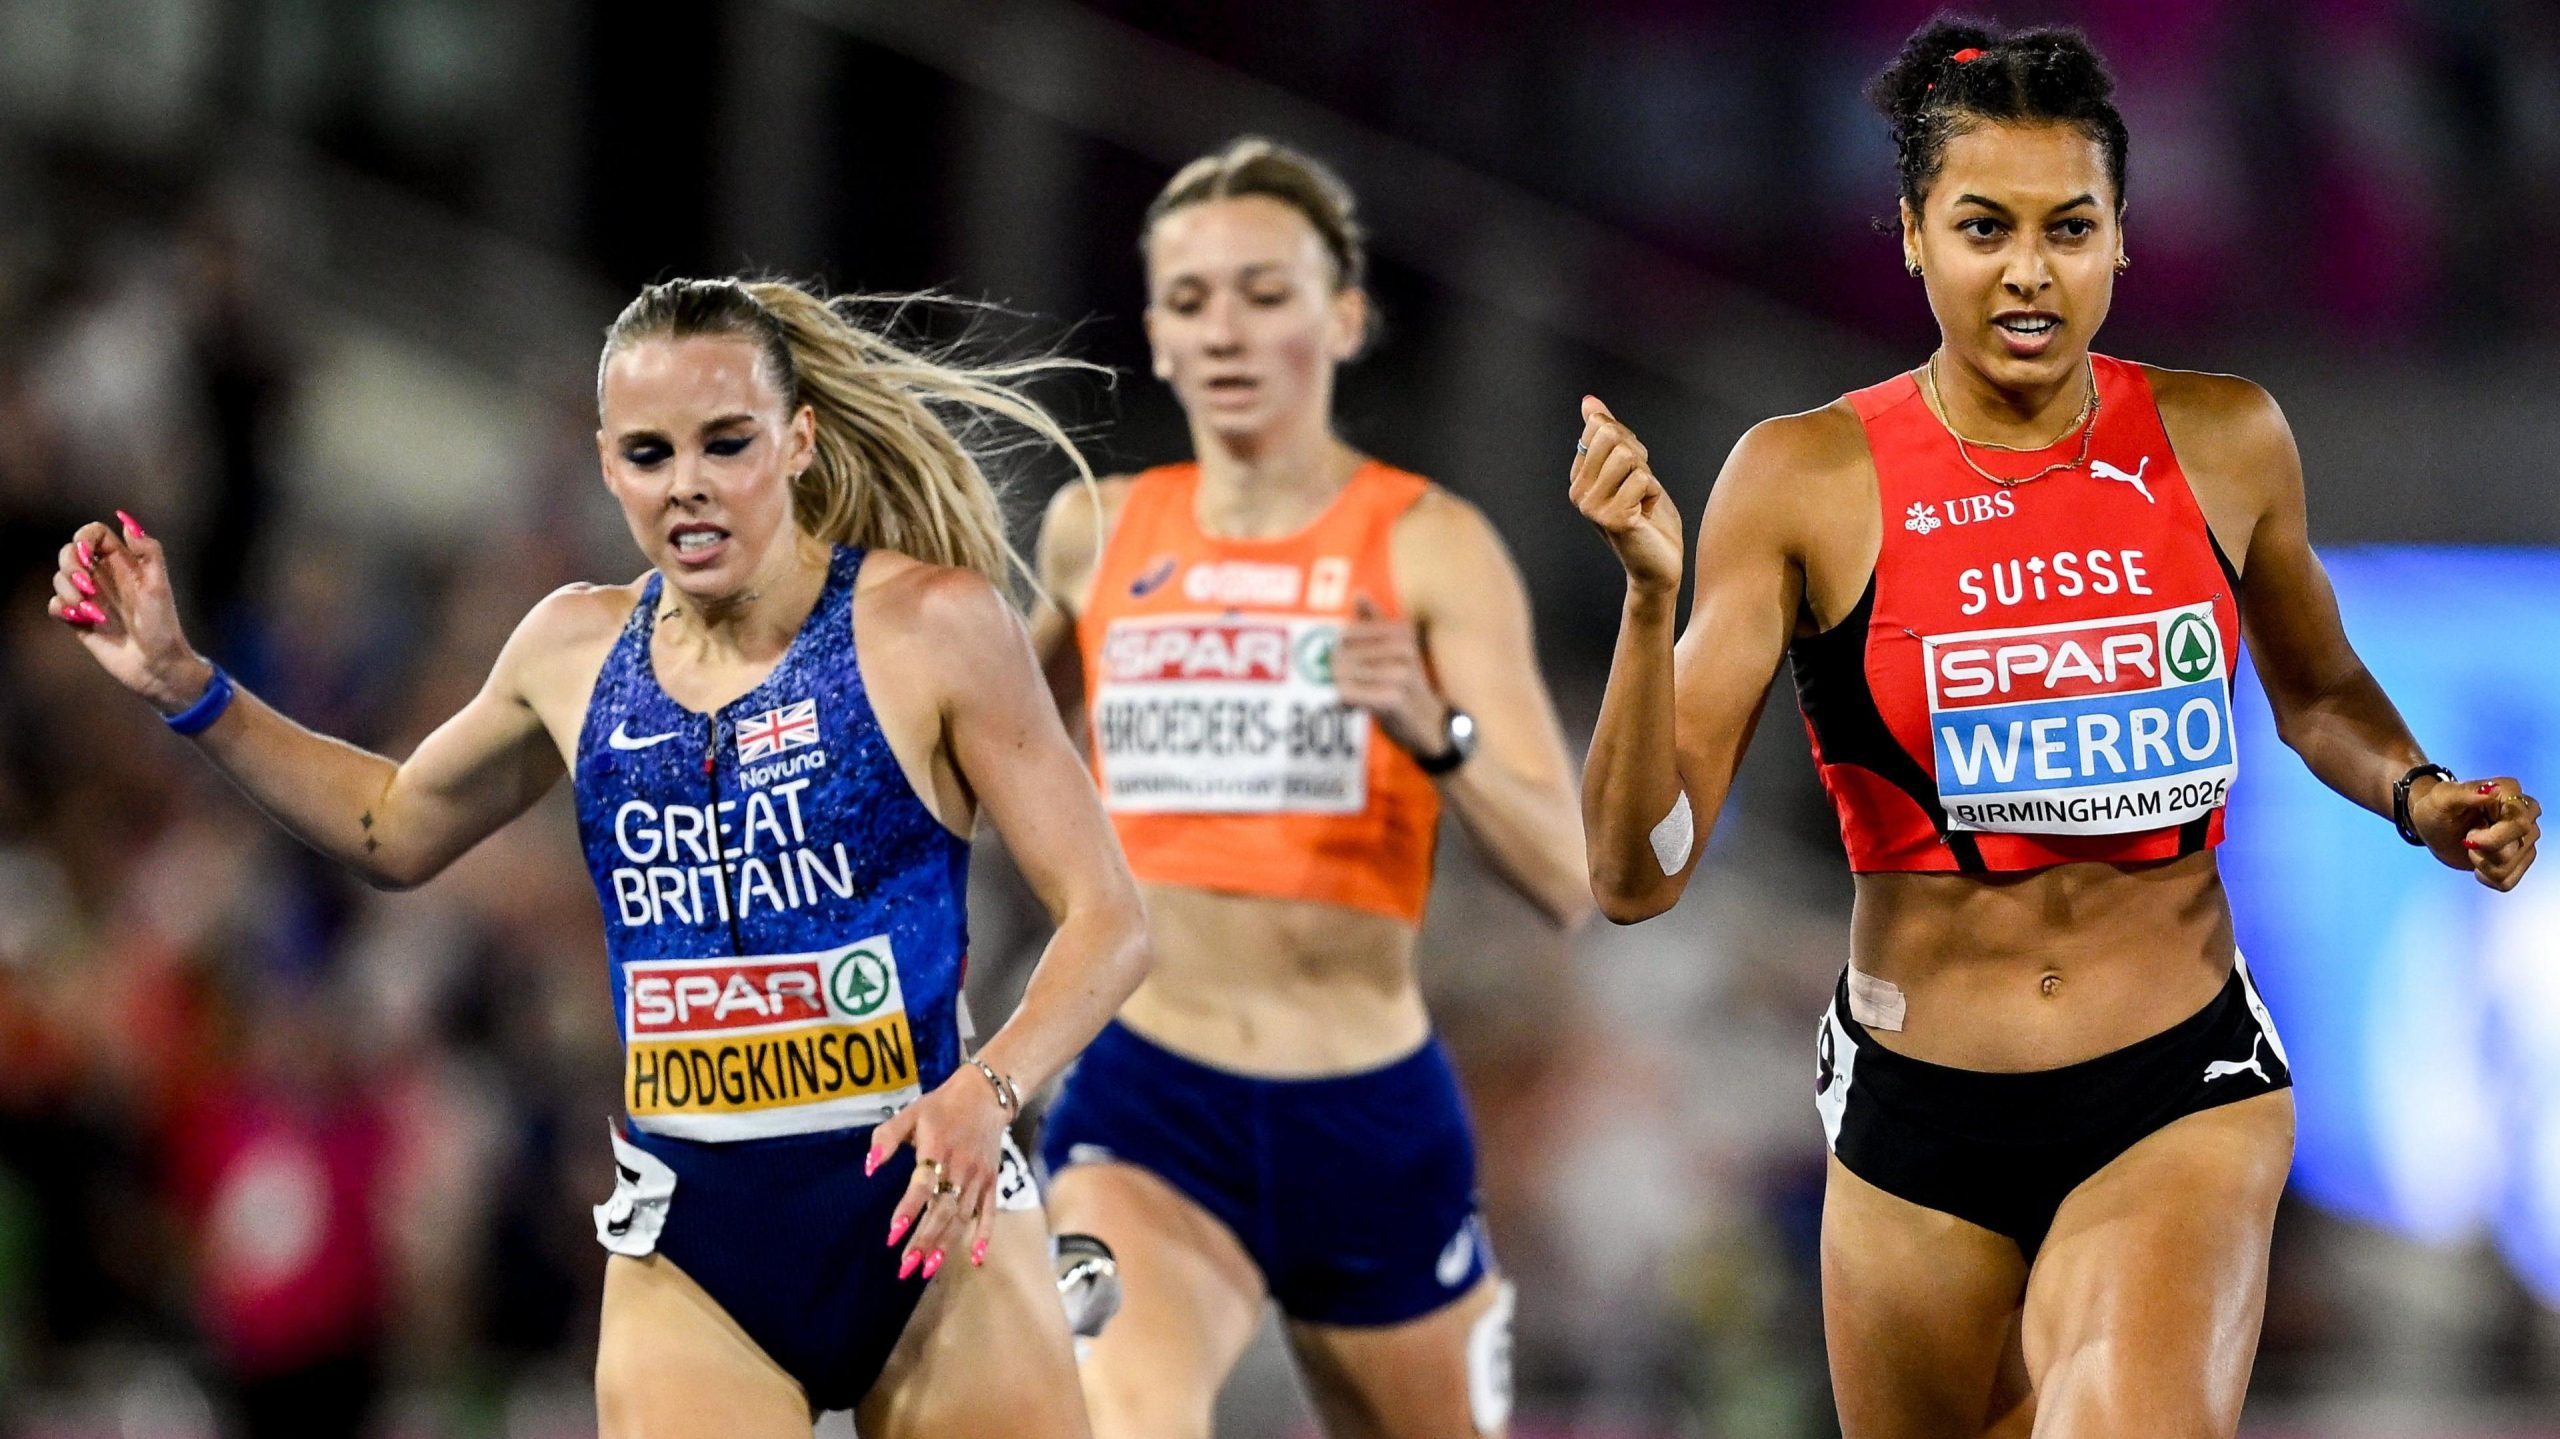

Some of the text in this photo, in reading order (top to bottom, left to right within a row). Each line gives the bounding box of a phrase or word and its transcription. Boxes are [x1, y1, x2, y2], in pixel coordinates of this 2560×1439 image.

[1945, 490, 2015, 526] UBS
[1105, 630, 1283, 681] SPAR
[1940, 632, 2156, 699] SPAR
[740, 750, 827, 792] Novuna
[1941, 697, 2221, 786] WERRO
[614, 778, 810, 864] GREAT
[1956, 777, 2226, 824] BIRMINGHAM 2026
[612, 842, 855, 927] BRITAIN
[636, 970, 822, 1025] SPAR
[634, 1022, 907, 1108] HODGKINSON
